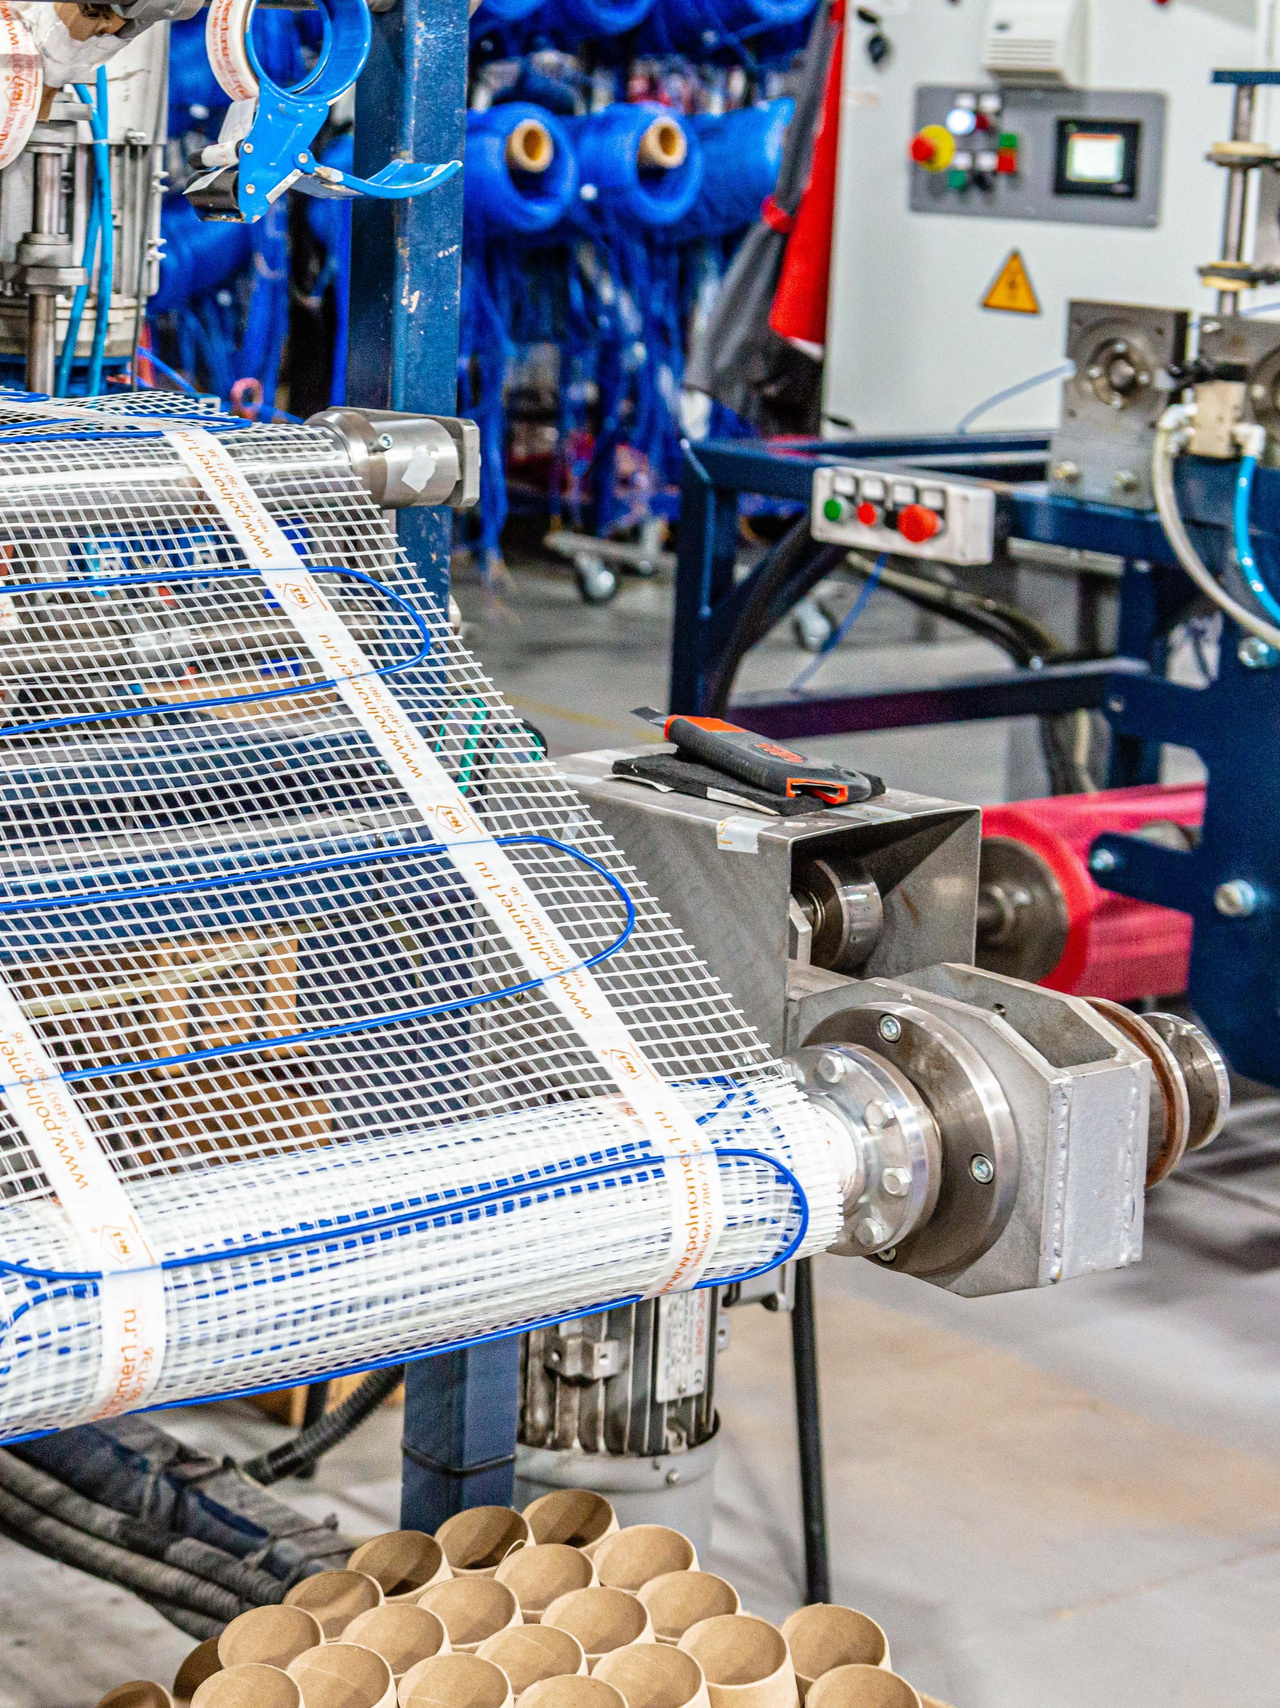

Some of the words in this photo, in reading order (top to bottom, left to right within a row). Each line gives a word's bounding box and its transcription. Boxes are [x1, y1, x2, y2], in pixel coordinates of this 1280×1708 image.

[177, 431, 273, 559] www.polnomer1.ru
[318, 634, 423, 778] www.polnomer1.ru
[474, 861, 593, 1020] www.polnomer1.ru
